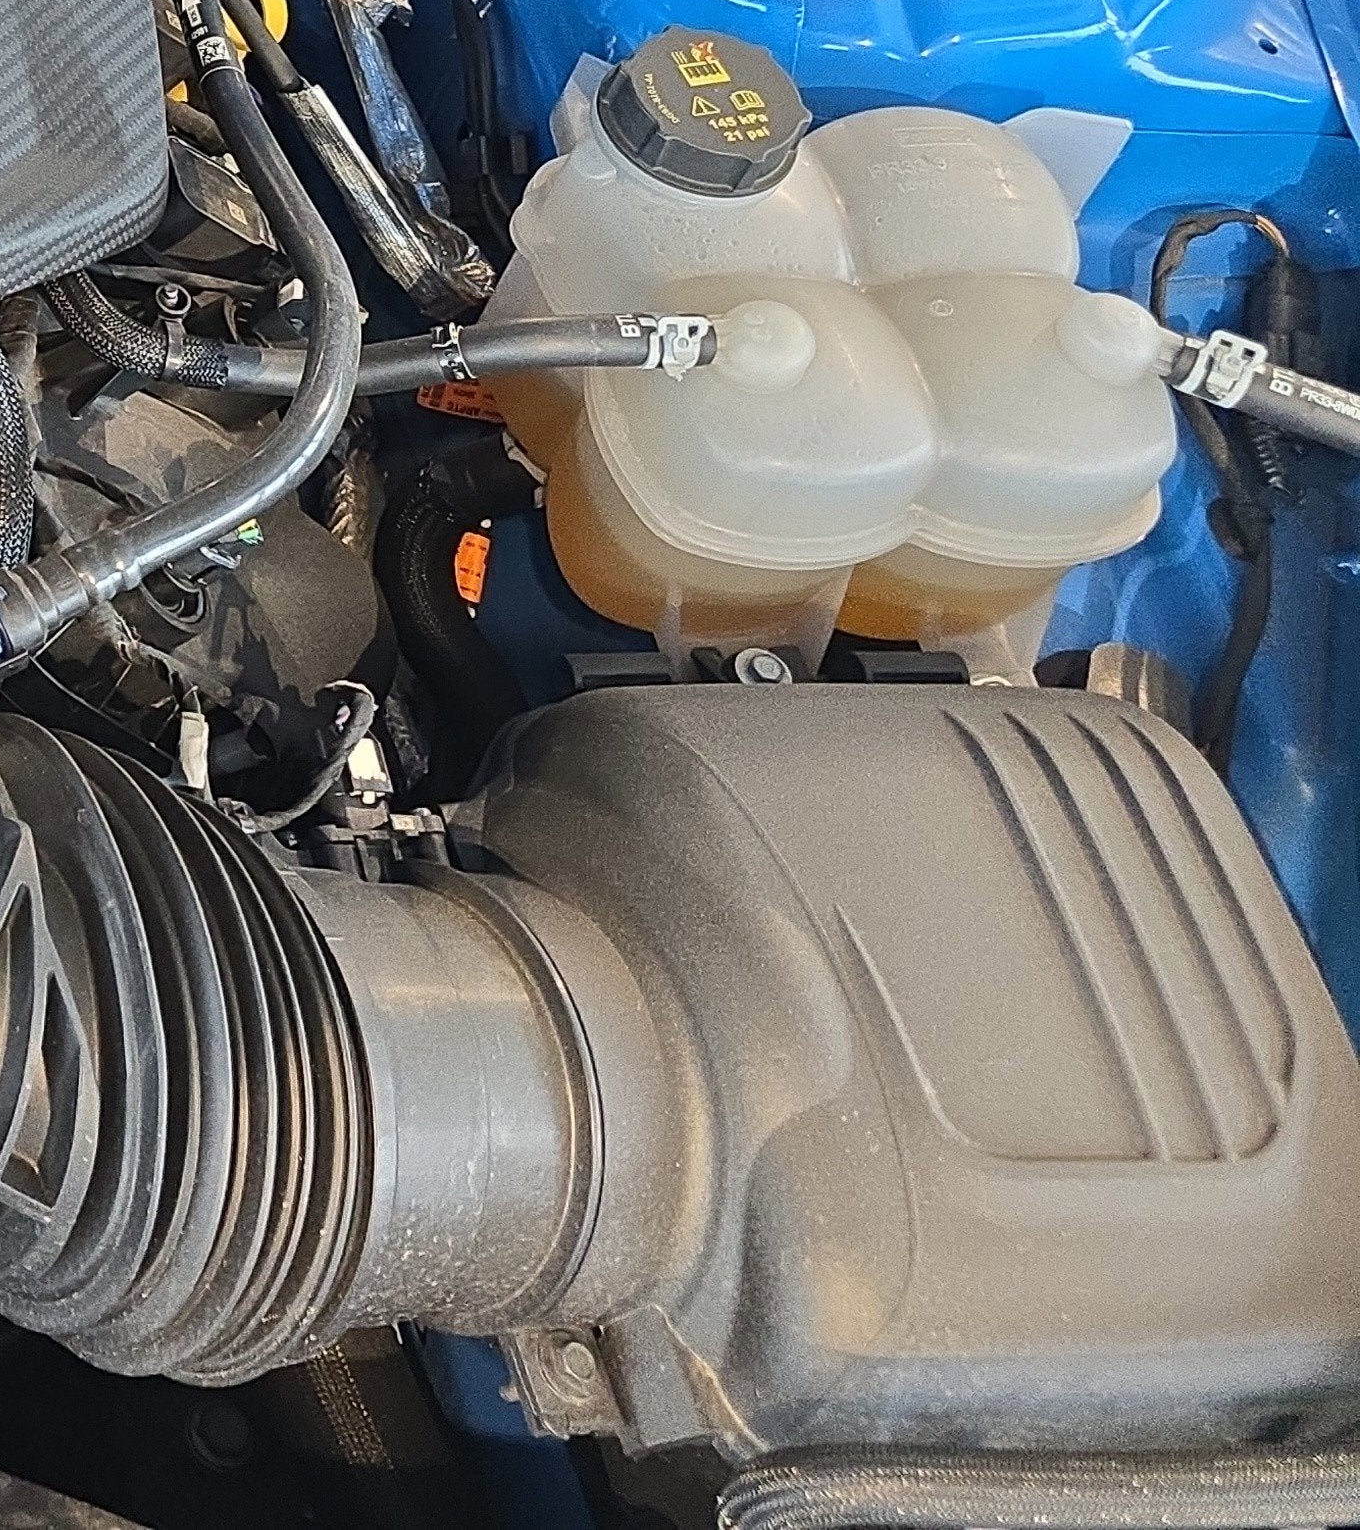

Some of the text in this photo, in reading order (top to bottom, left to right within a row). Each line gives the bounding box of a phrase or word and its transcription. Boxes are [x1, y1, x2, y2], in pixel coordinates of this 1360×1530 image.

[708, 113, 768, 130] 145 kPa
[723, 127, 770, 143] 21 psi
